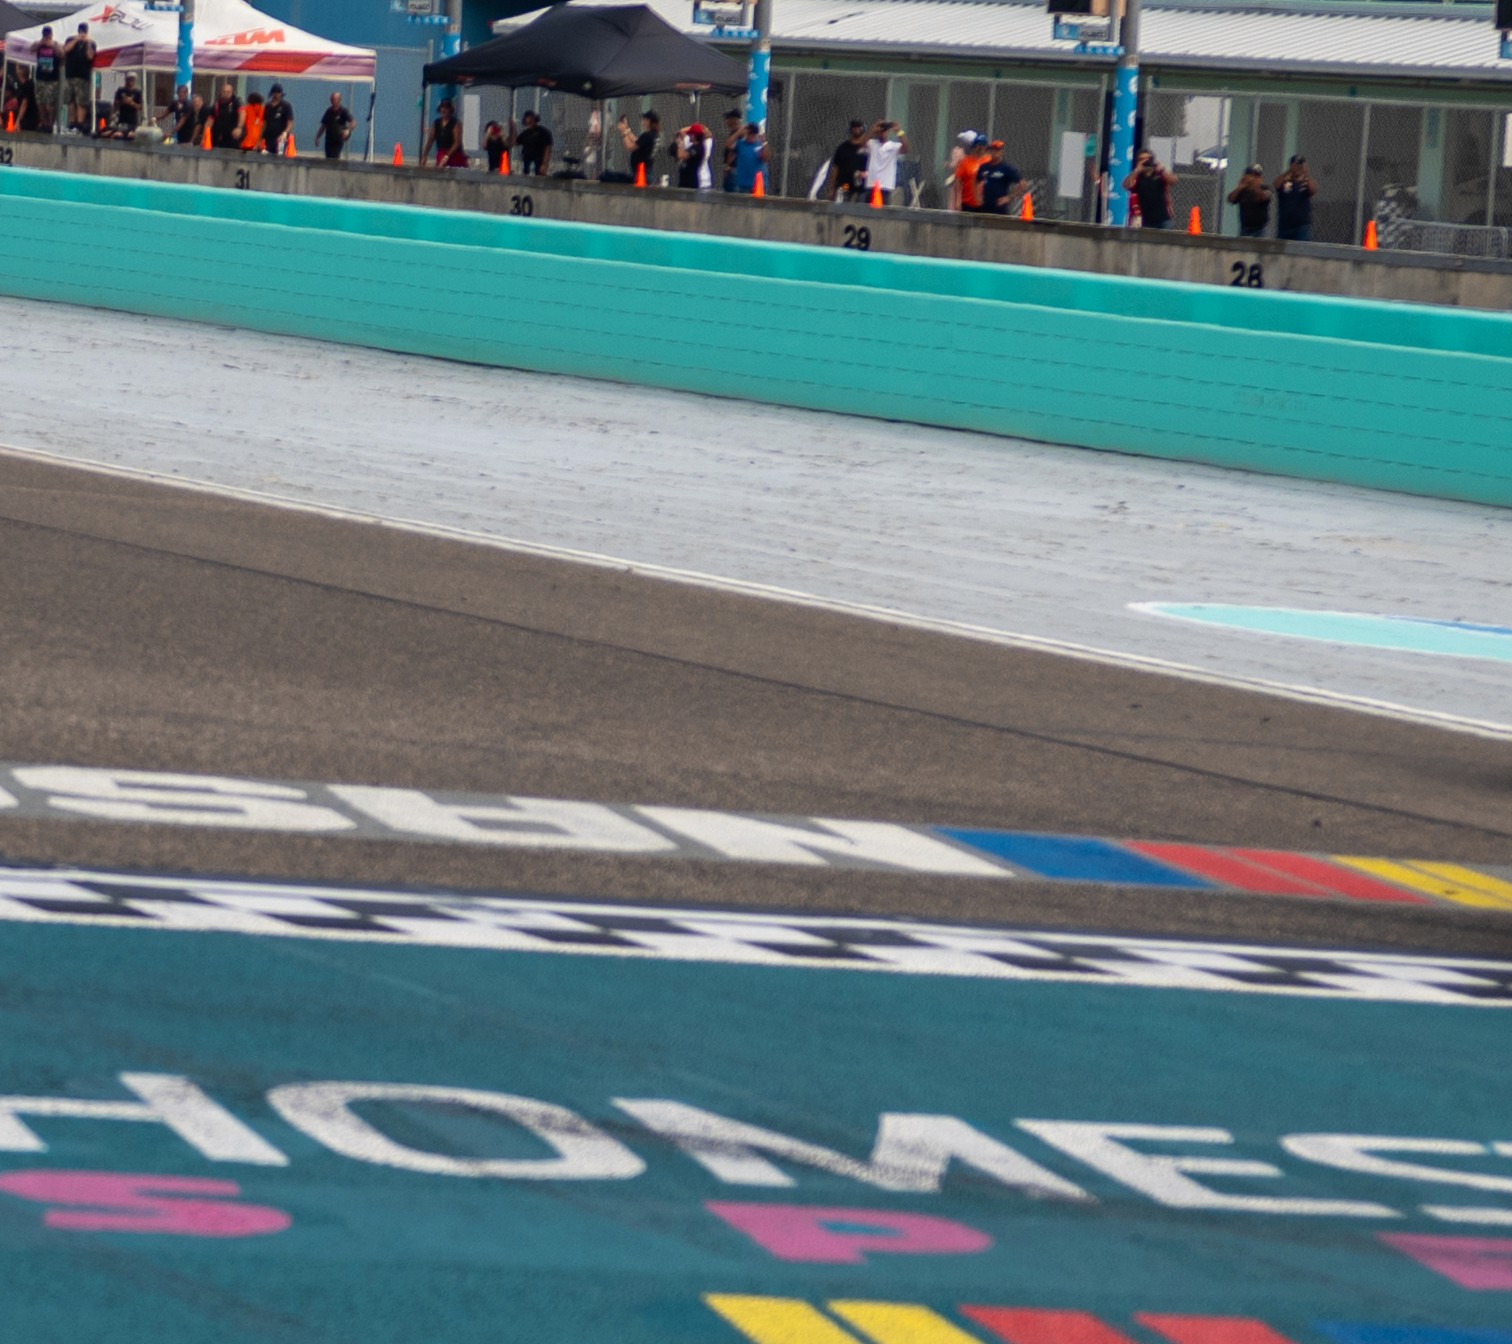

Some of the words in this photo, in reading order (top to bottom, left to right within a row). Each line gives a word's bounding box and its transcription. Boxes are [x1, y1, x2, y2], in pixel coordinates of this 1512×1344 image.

[235, 167, 251, 190] 31
[510, 195, 534, 217] 30
[843, 224, 871, 251] 29
[1231, 260, 1263, 288] 28
